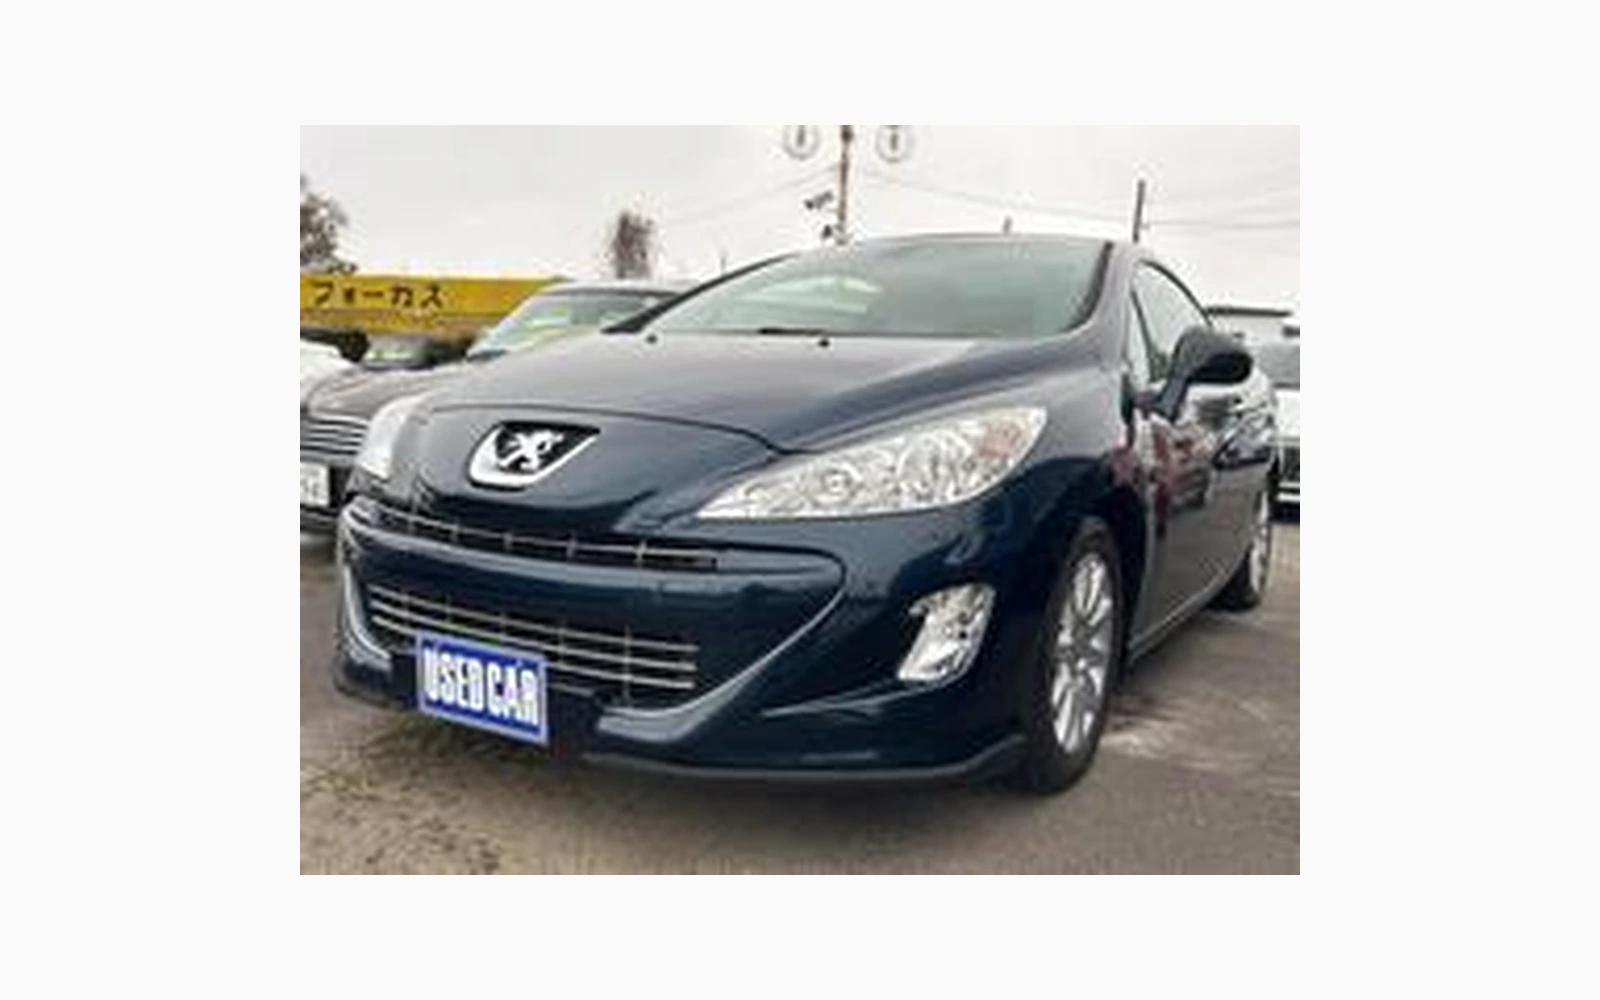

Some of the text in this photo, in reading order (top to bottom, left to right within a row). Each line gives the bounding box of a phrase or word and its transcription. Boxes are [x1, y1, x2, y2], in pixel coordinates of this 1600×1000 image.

[310, 280, 443, 308] フォーカス
[424, 648, 539, 726] USED CAR
